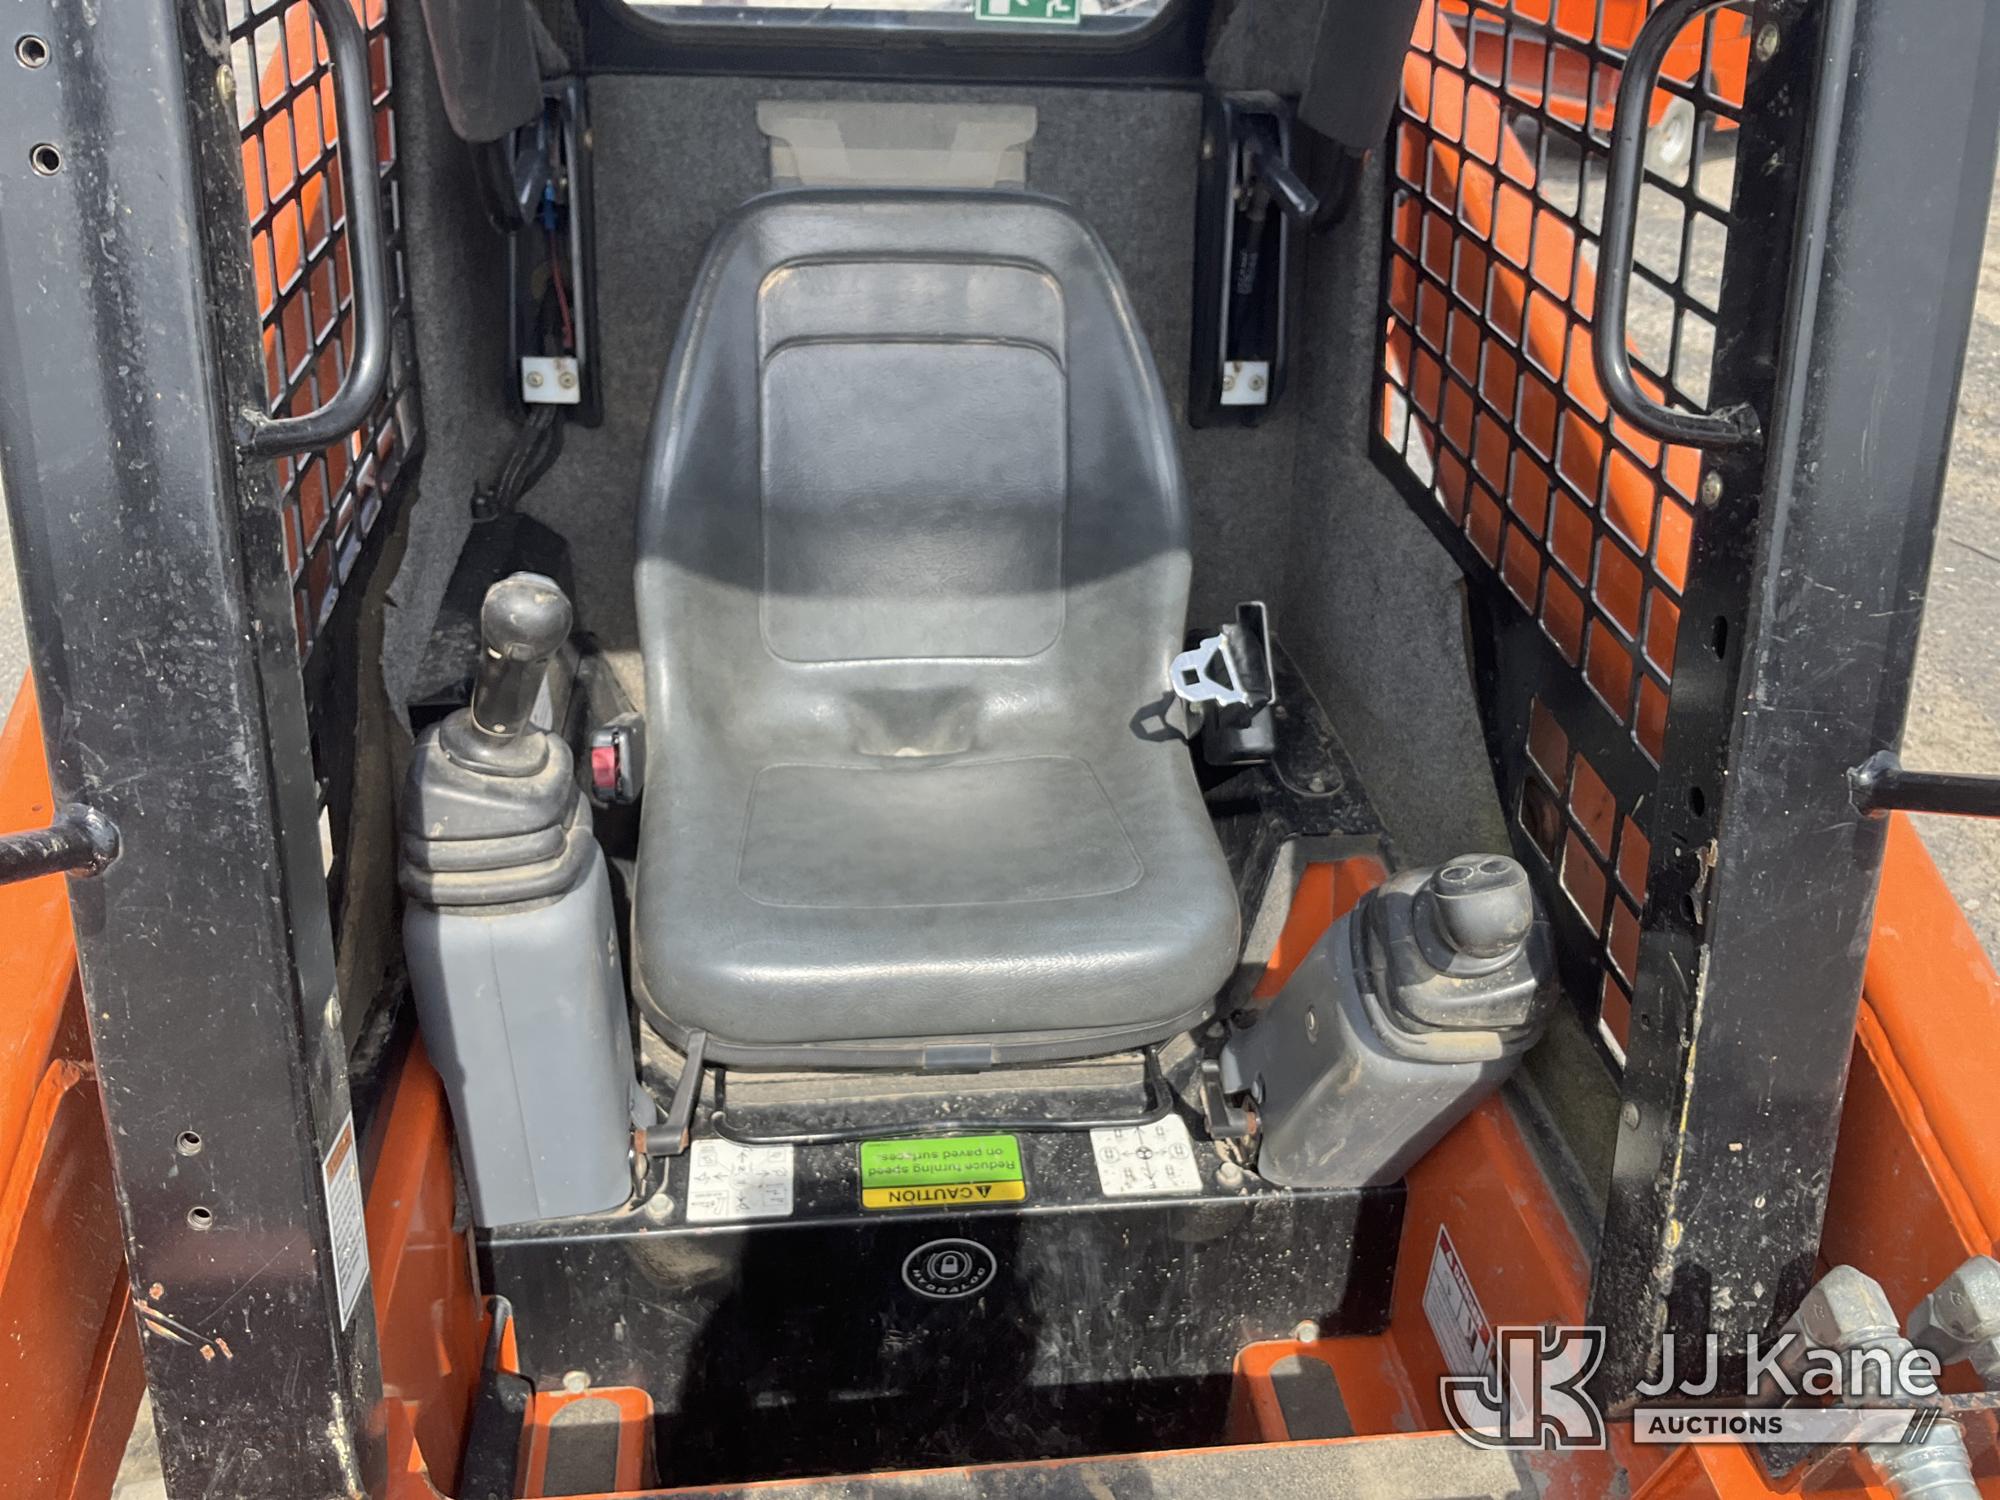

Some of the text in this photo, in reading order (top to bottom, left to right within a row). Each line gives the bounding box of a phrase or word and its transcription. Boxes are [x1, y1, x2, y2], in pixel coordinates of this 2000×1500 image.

[942, 1148, 982, 1159] paved
[869, 1160, 1015, 1177] Reduce turning speed
[889, 1187, 973, 1203] CAUTION
